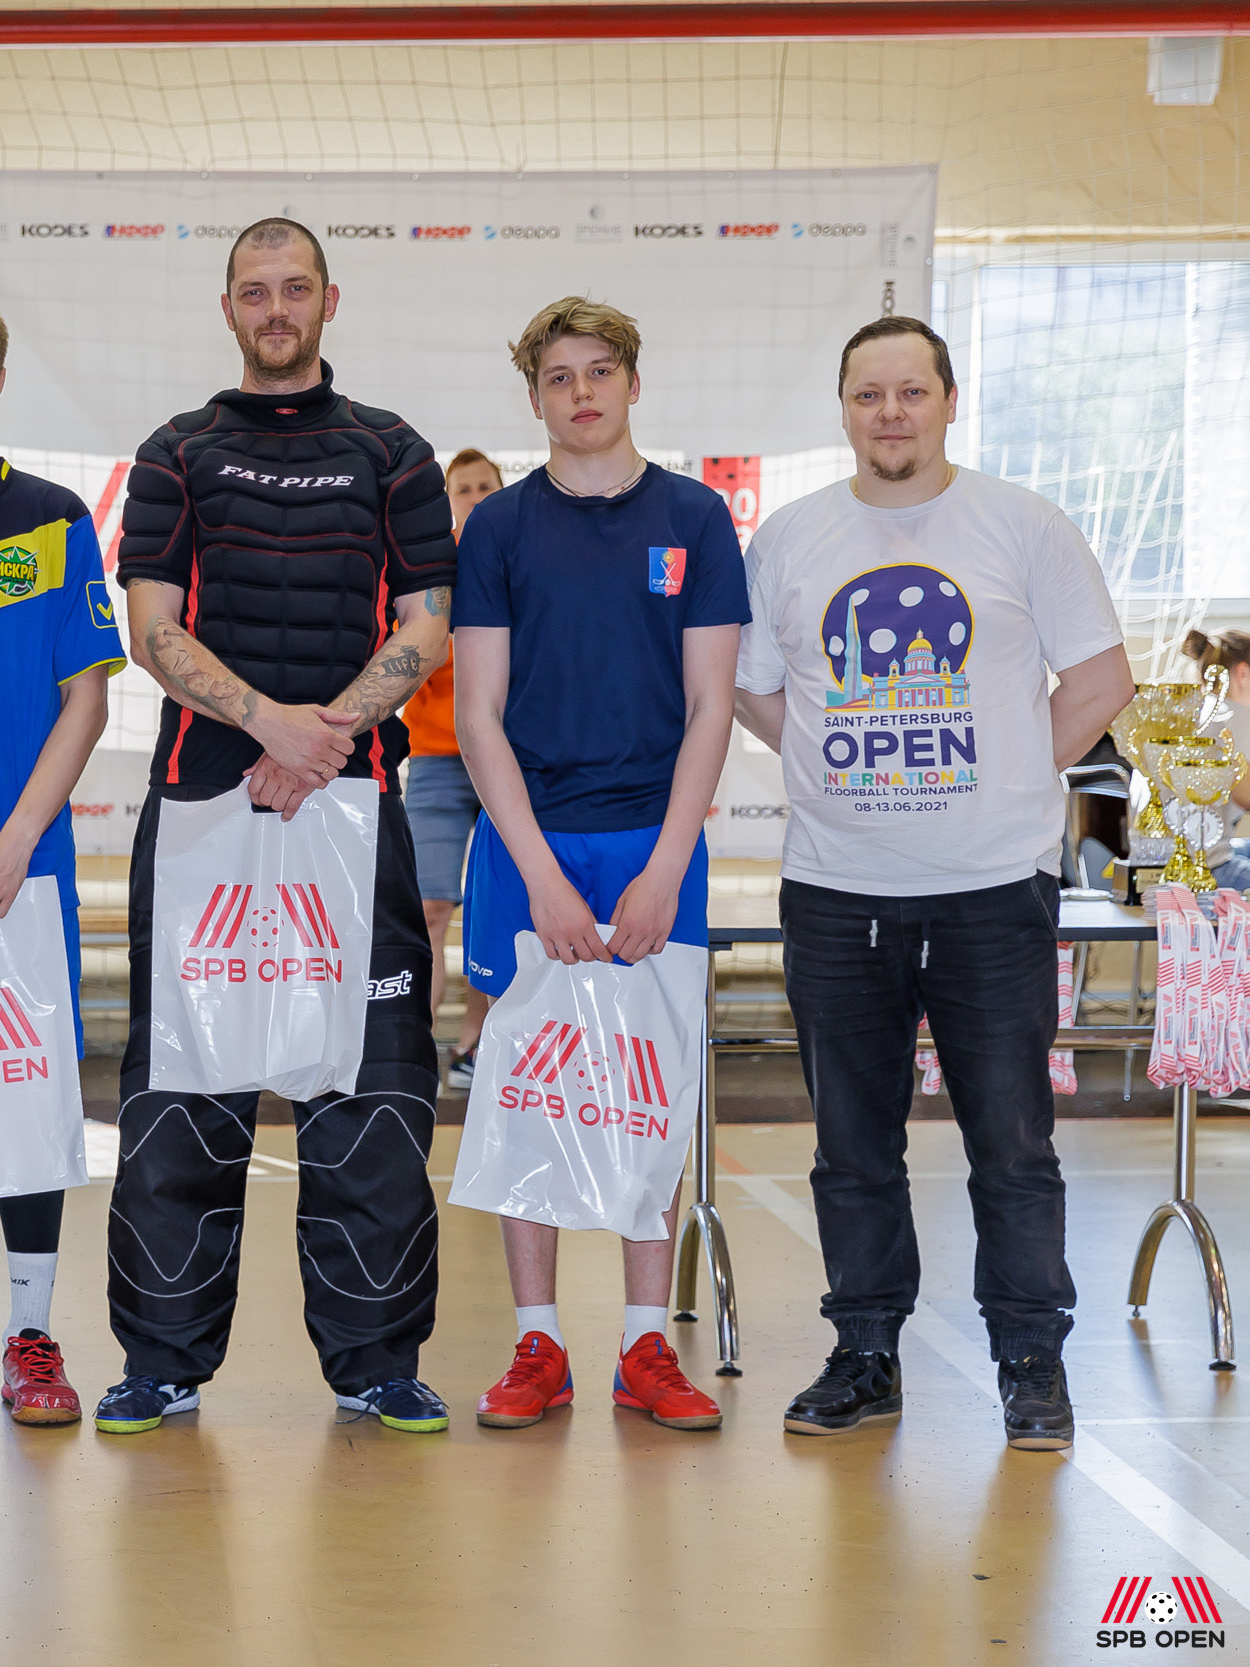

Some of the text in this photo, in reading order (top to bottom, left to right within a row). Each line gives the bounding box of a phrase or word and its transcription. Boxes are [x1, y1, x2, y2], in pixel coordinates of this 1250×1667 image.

[21, 223, 90, 237] KODES
[193, 224, 248, 239] depp
[327, 224, 398, 239] KODES
[500, 225, 561, 239] deppa
[634, 224, 704, 238] KODES
[808, 222, 867, 237] deppa
[218, 465, 354, 488] FAT PIPE
[824, 711, 973, 727] SAINT-PETERSBURG
[822, 727, 977, 769] OPEN
[824, 769, 978, 786] INTERNATIONAL
[824, 783, 978, 796] FLOORBALL TOURNAMENT
[731, 804, 791, 819] KODE
[854, 801, 948, 812] 08-13.06.2021
[181, 957, 343, 983] SPB OPEN
[499, 1086, 669, 1141] SPB OPEN
